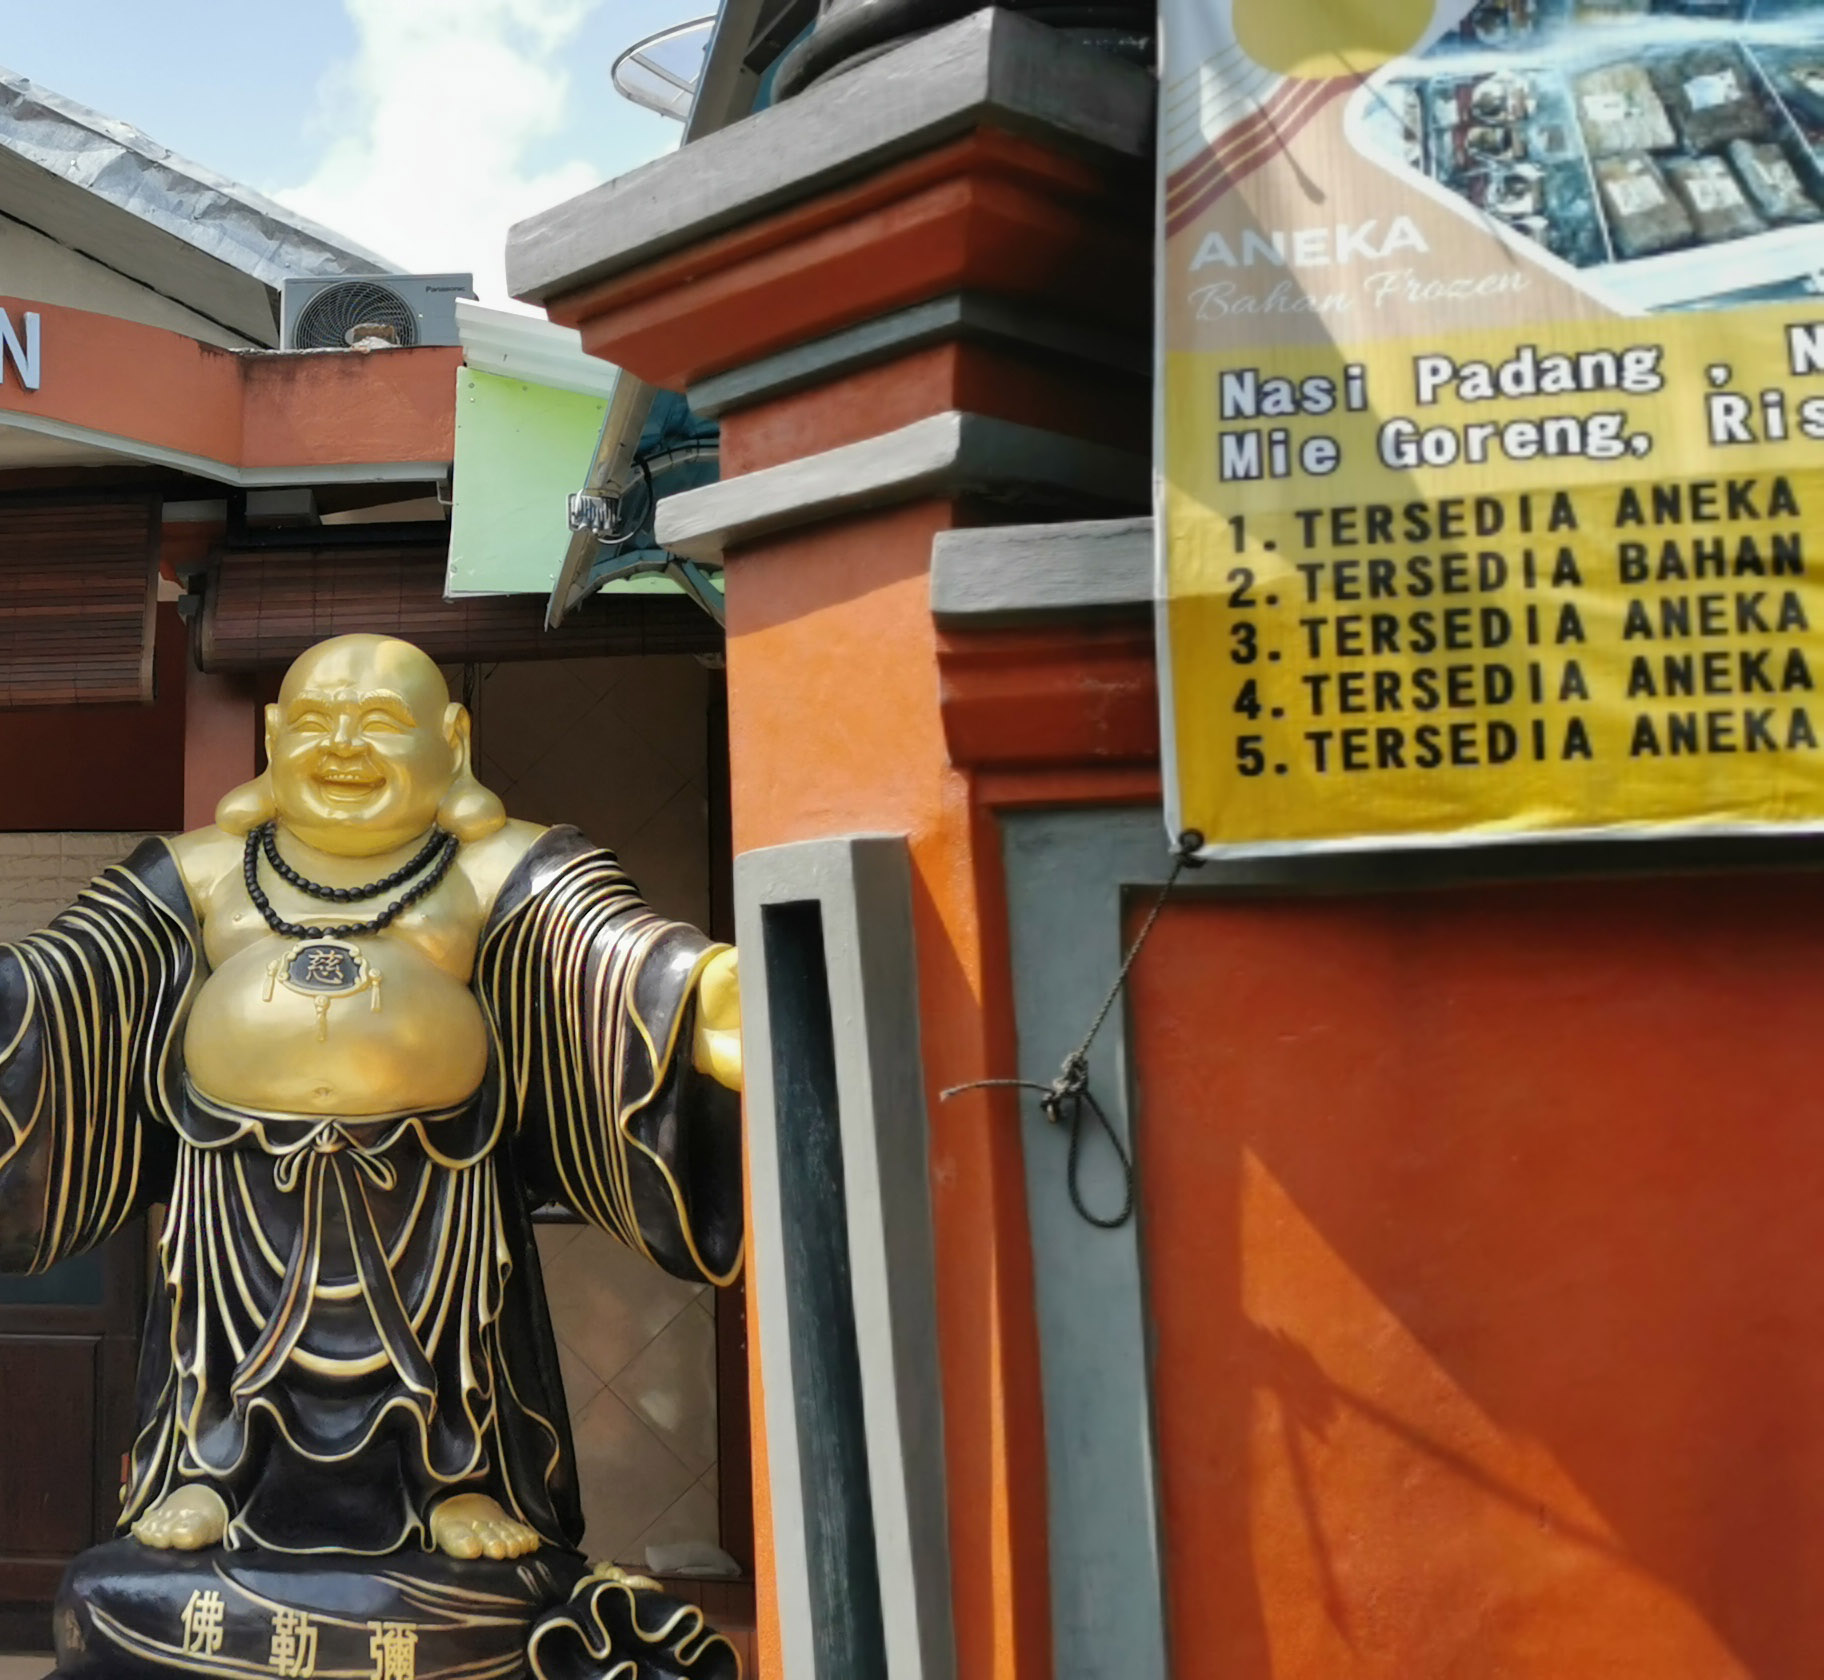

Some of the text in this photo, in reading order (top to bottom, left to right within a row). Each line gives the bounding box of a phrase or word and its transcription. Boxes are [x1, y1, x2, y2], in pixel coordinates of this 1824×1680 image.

[1188, 214, 1430, 272] ANEKA
[1188, 266, 1532, 321] Bahan Frozen
[1219, 363, 1368, 422] Nasi
[1413, 344, 1664, 405] Padang
[1219, 431, 1342, 483] Mie
[1379, 410, 1653, 470] Goreng,
[1613, 476, 1802, 529] ANEKA
[1618, 533, 1806, 586] BAHAN
[1622, 590, 1811, 641] ANEKA
[1626, 647, 1815, 699] ANEKA
[1629, 706, 1820, 758] ANEKA
[305, 949, 344, 986] 慈
